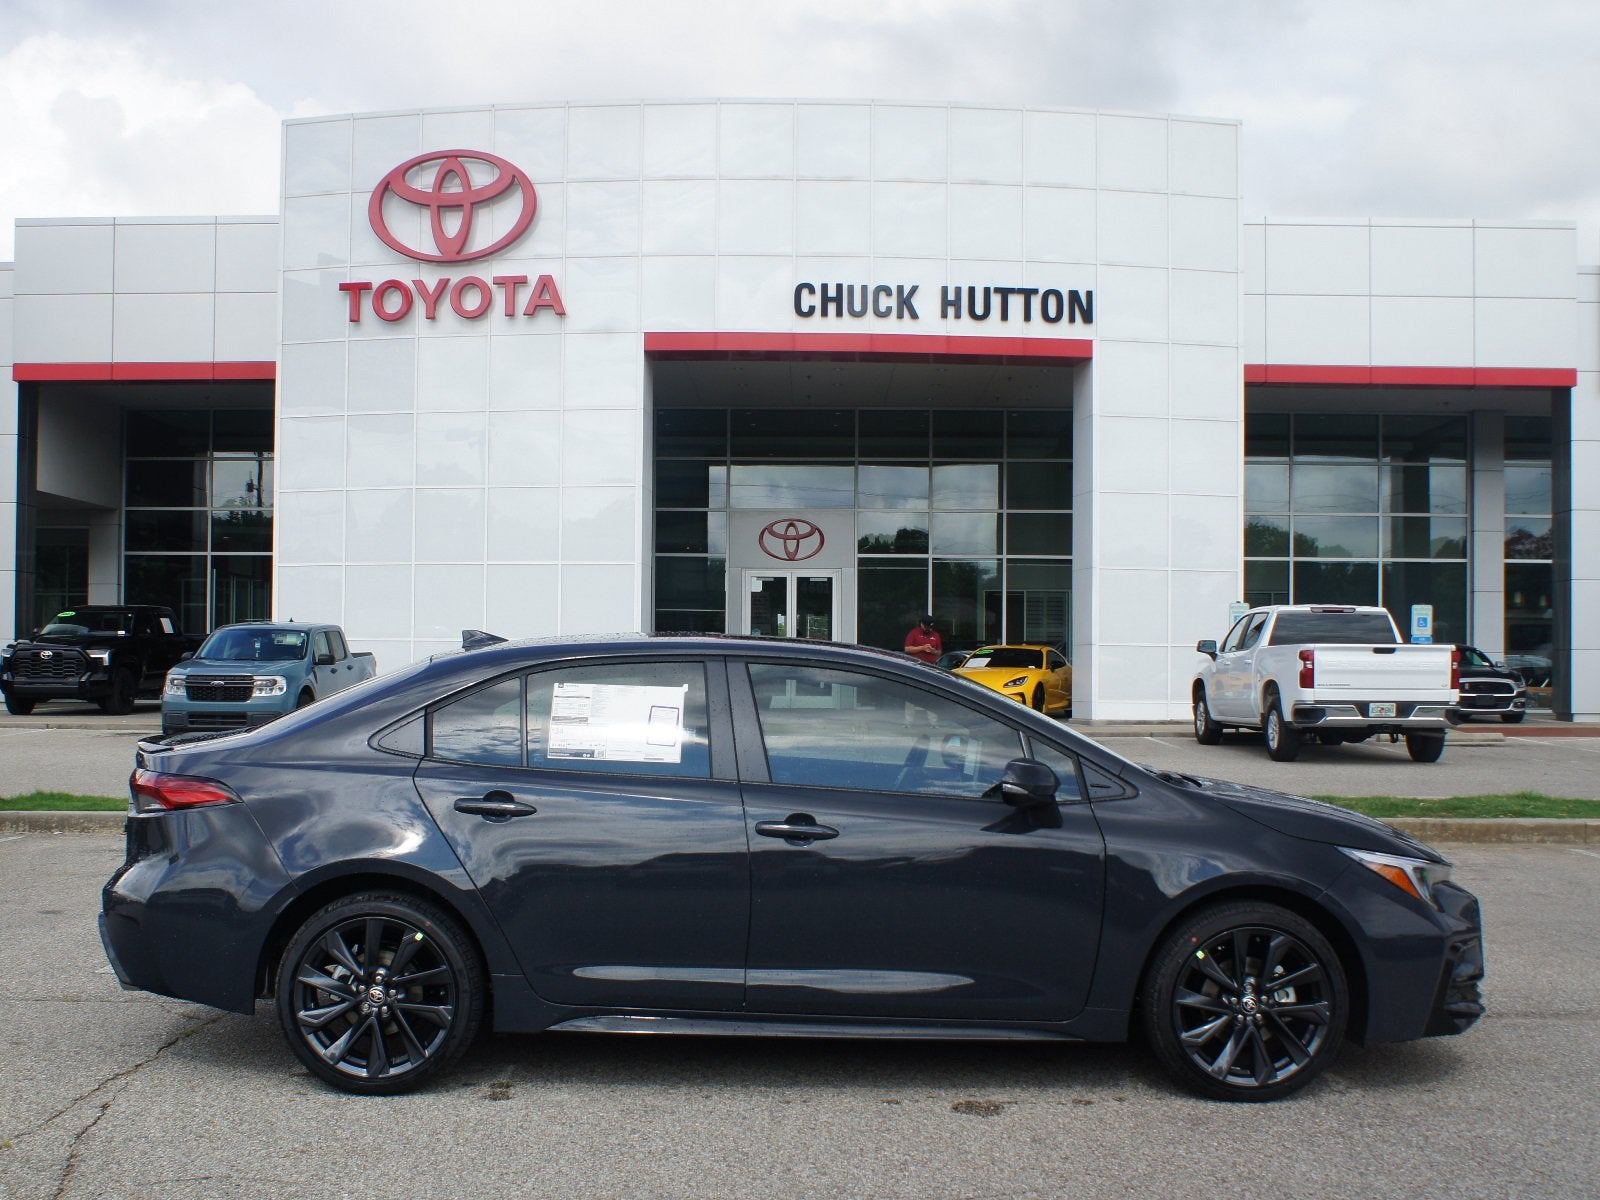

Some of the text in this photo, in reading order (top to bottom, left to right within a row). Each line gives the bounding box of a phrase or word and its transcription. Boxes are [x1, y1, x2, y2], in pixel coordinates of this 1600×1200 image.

[339, 275, 566, 323] TOYOTA
[794, 282, 1094, 325] CHUCK HUTTON
